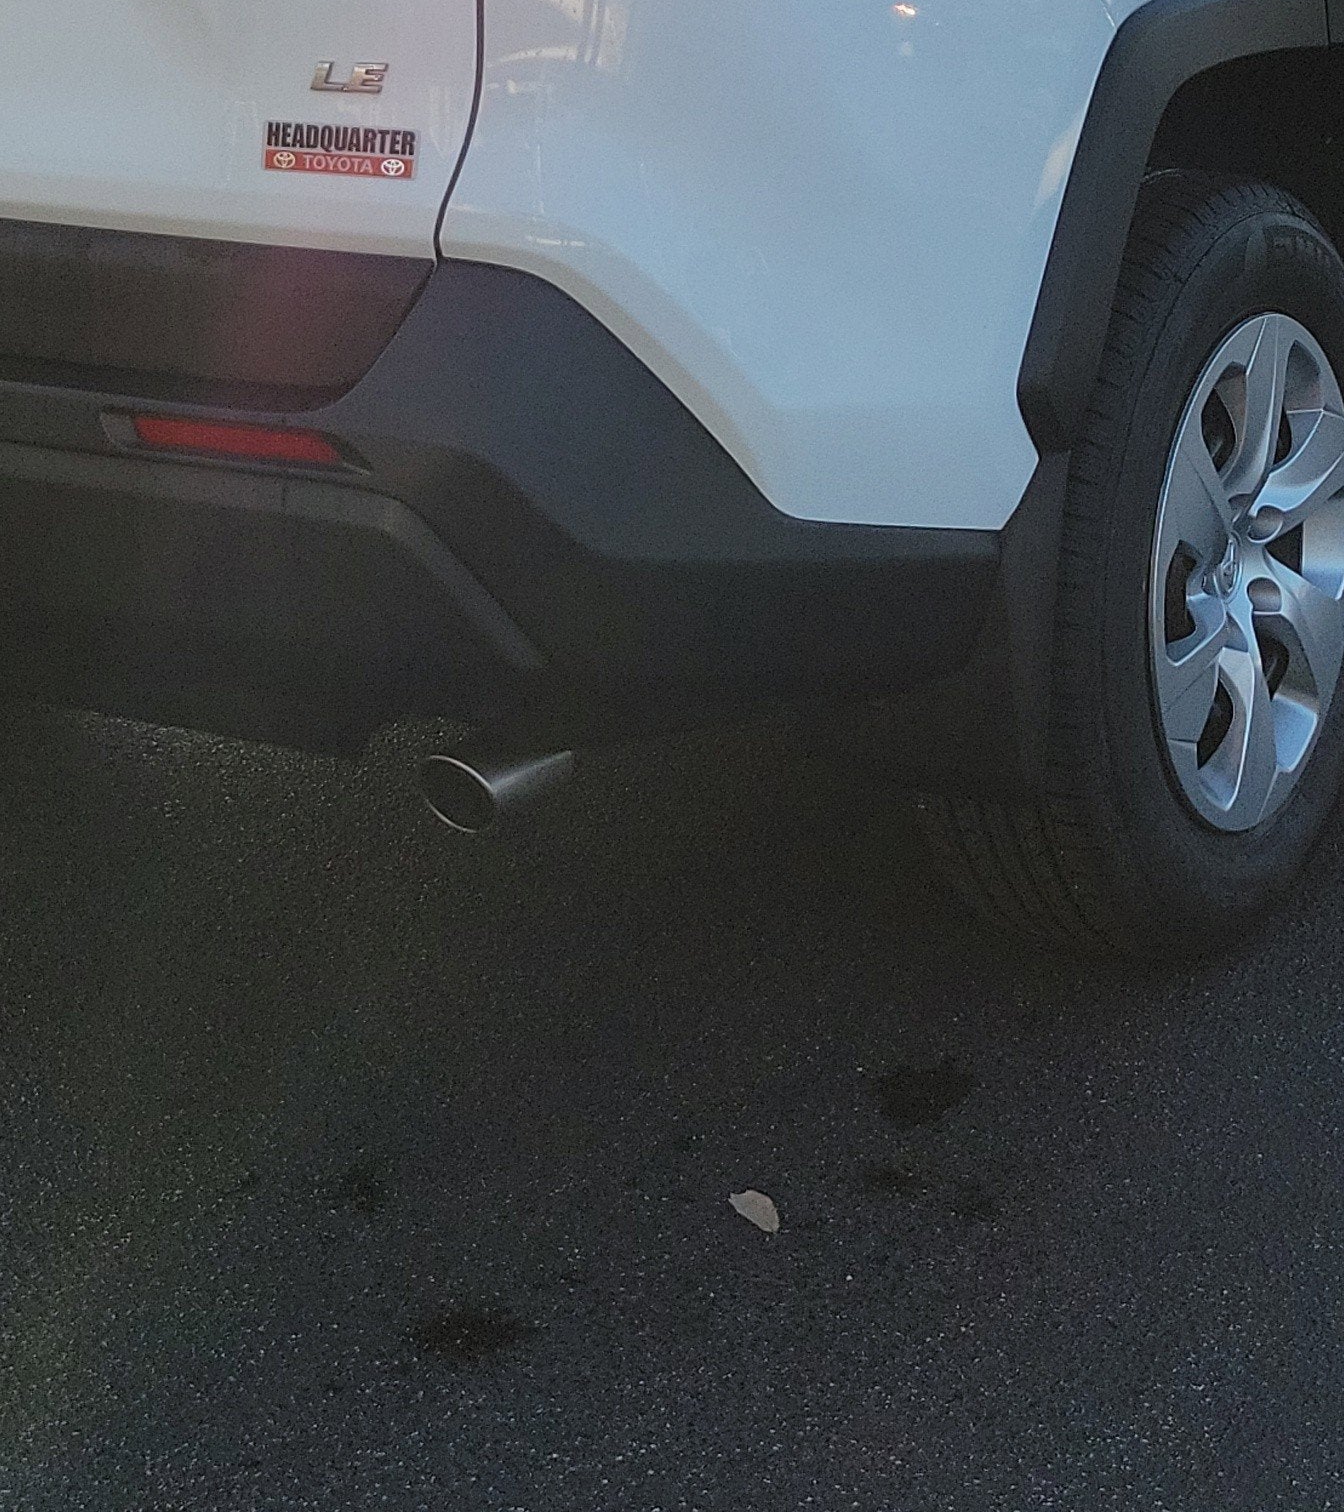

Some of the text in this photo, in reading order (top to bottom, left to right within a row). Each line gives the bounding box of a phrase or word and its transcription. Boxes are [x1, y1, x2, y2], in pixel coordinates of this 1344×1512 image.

[310, 60, 389, 94] LE
[266, 121, 416, 156] HEADQUARTER
[302, 154, 374, 173] TOYOTA
